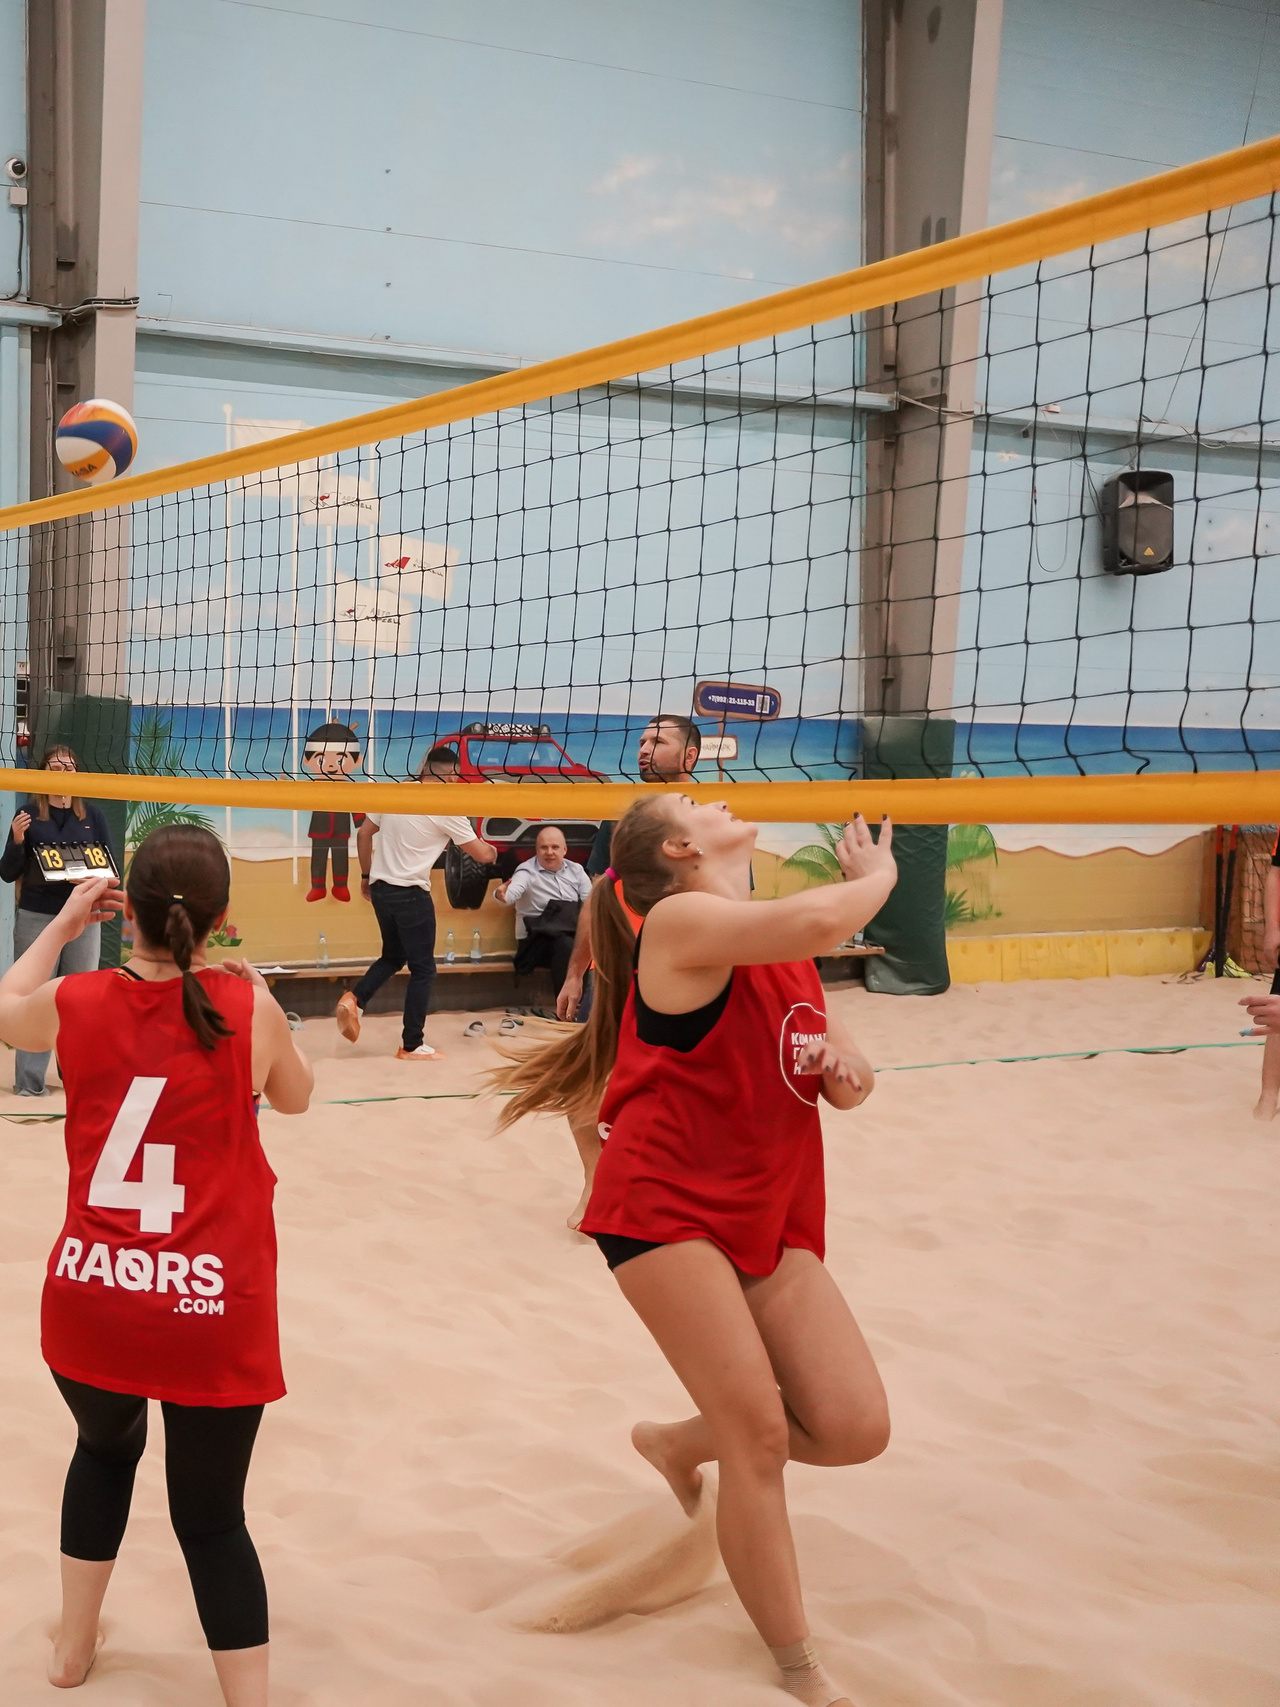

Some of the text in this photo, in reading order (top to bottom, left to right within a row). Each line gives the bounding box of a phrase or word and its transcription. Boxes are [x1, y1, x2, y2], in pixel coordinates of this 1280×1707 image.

[41, 847, 106, 868] 13 18
[87, 1076, 185, 1234] 4
[55, 1236, 224, 1297] RAQRS
[173, 1297, 225, 1316] .COM
